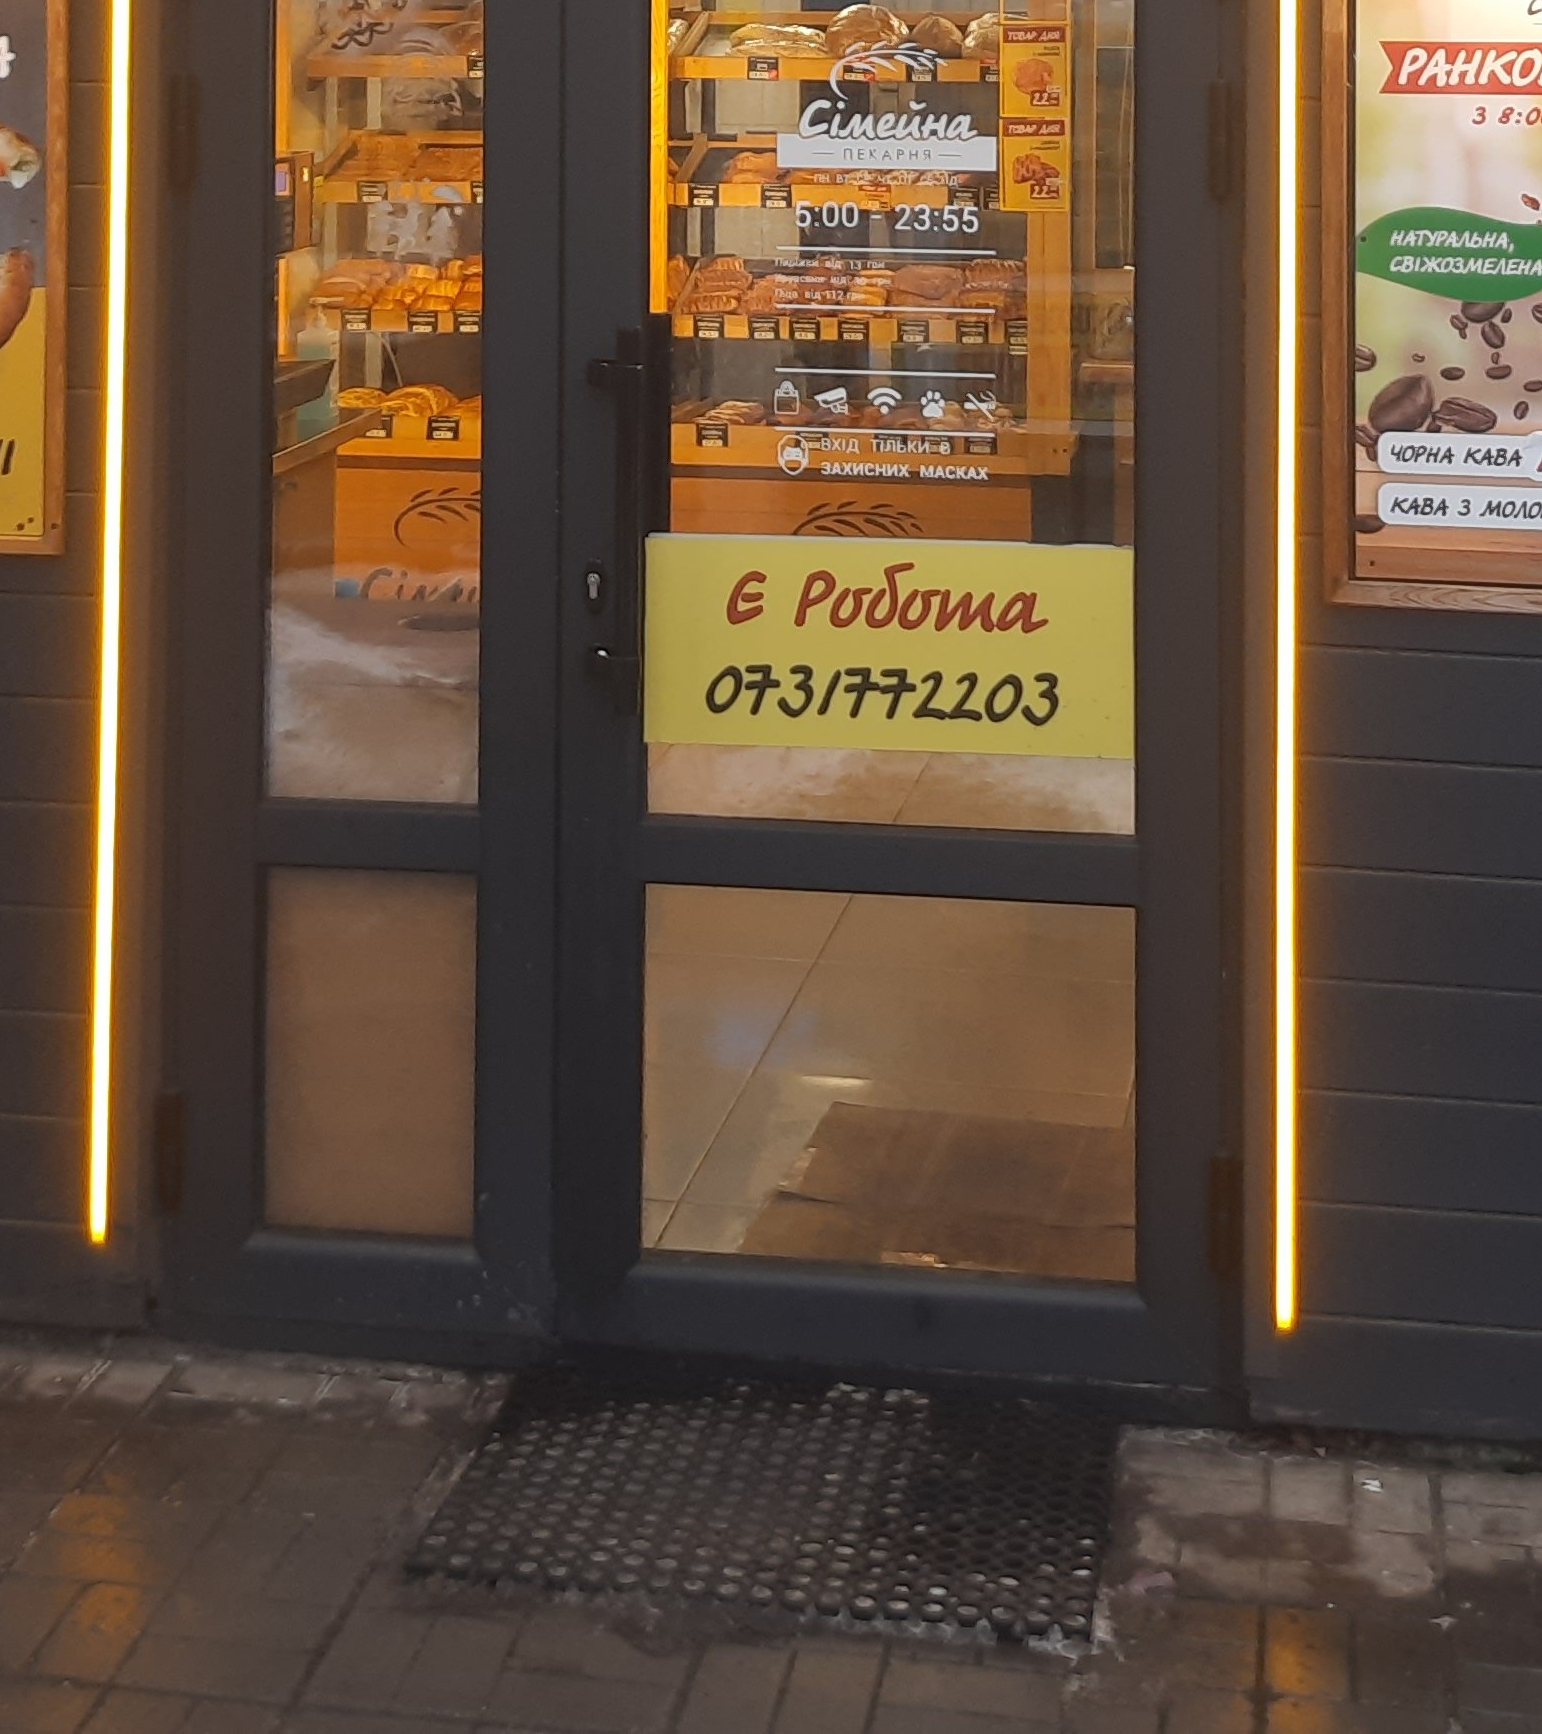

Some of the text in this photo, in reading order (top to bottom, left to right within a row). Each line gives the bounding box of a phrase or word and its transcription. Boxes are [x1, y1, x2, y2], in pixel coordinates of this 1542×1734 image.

[798, 99, 979, 141] Сімейна
[843, 147, 932, 163] ПЕКАРНЯ
[795, 200, 859, 228] 5:00
[894, 203, 980, 233] 23:55
[1390, 229, 1515, 252] НАТУРАЛЬНА,
[821, 437, 951, 455] ВХІД ТІЛЬКИ В
[1390, 444, 1455, 466] ЧОРНА
[1463, 447, 1523, 468] КАВА
[820, 461, 989, 481] ЗАХИСНИХ МАСКАХ
[1390, 496, 1450, 518] КАВА
[794, 562, 1049, 635] Робота
[705, 664, 1060, 727] 0731772203
